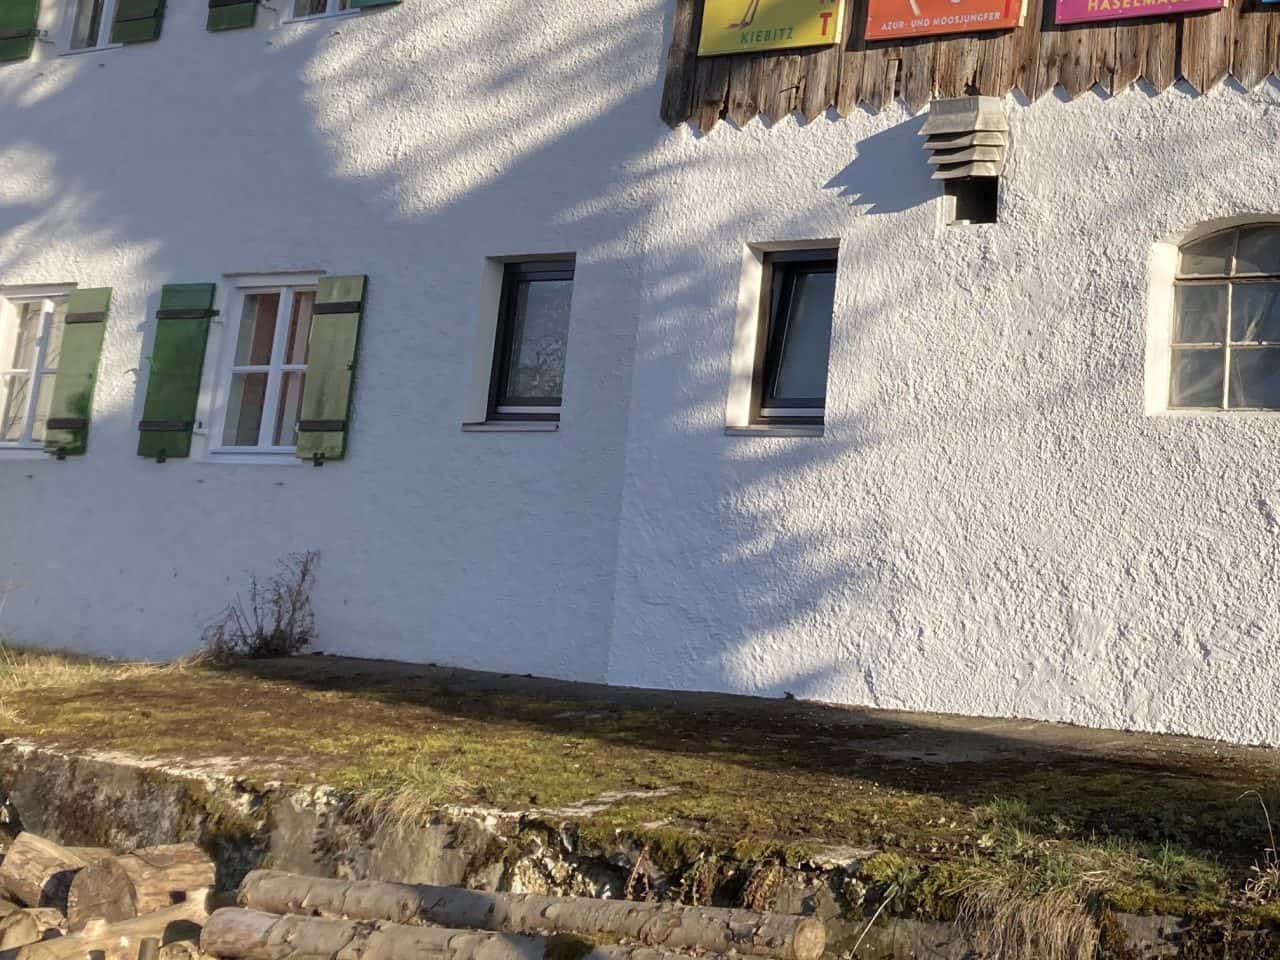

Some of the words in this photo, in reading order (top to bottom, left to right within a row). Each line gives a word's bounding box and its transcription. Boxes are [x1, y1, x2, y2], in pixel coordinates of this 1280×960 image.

[911, 19, 929, 28] UND
[933, 11, 1001, 26] MOOSJUNGFER
[740, 27, 794, 44] KIEBITZ
